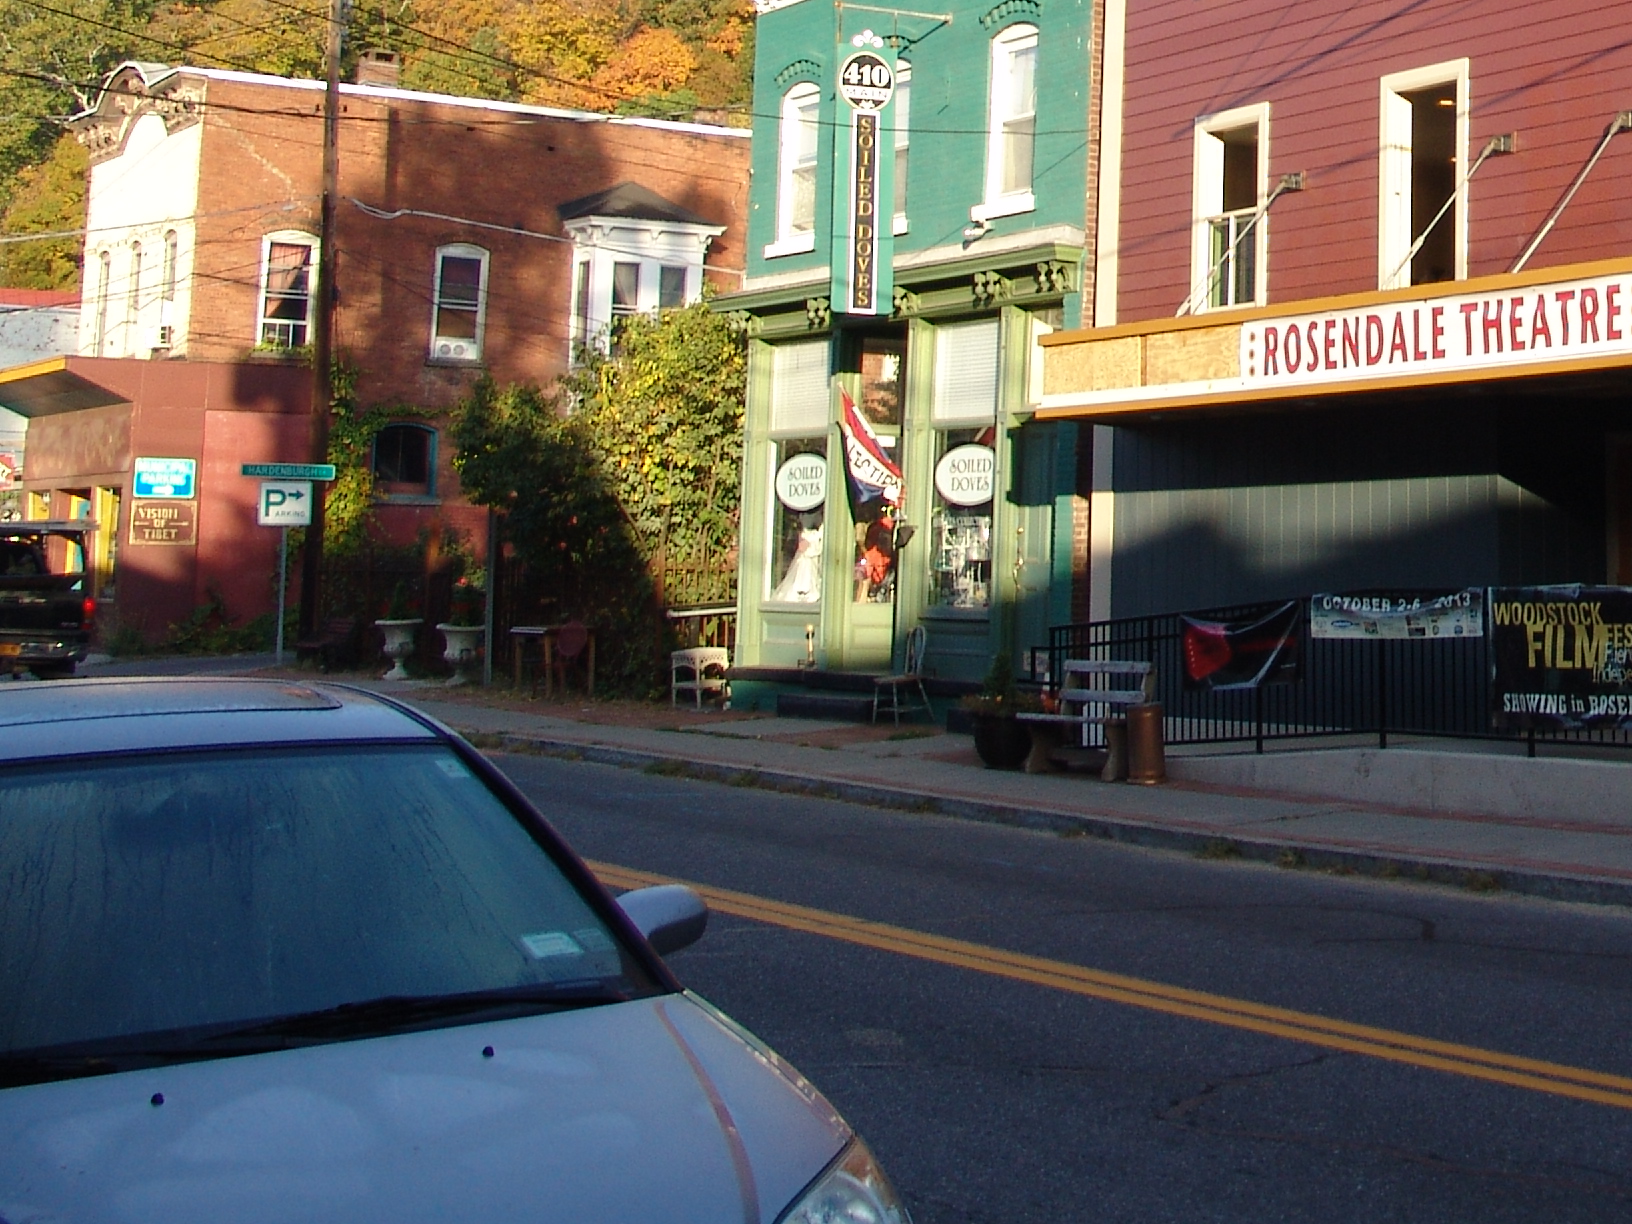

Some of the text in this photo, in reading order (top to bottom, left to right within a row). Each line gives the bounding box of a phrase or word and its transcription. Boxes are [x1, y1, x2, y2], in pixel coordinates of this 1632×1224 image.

[844, 62, 889, 87] 410
[846, 87, 887, 98] MAIN
[856, 118, 874, 306] SOILED DOVES
[1263, 284, 1623, 376] ROSENDALE THEATRE
[248, 465, 318, 476] HARDENBURGH
[787, 465, 823, 481] SOILED
[949, 458, 991, 473] SOILED
[140, 473, 187, 486] PARKING
[951, 476, 989, 492] DOVES
[789, 482, 820, 497] DOVES
[138, 507, 178, 519] VISION
[153, 519, 167, 528] OF
[143, 529, 178, 540] TIBET
[1323, 596, 1391, 612] OCTOBER
[1494, 601, 1605, 626] WOODSTOCK
[1525, 623, 1608, 670] FILM
[1503, 693, 1567, 715] SHOWING
[1570, 693, 1585, 713] in
